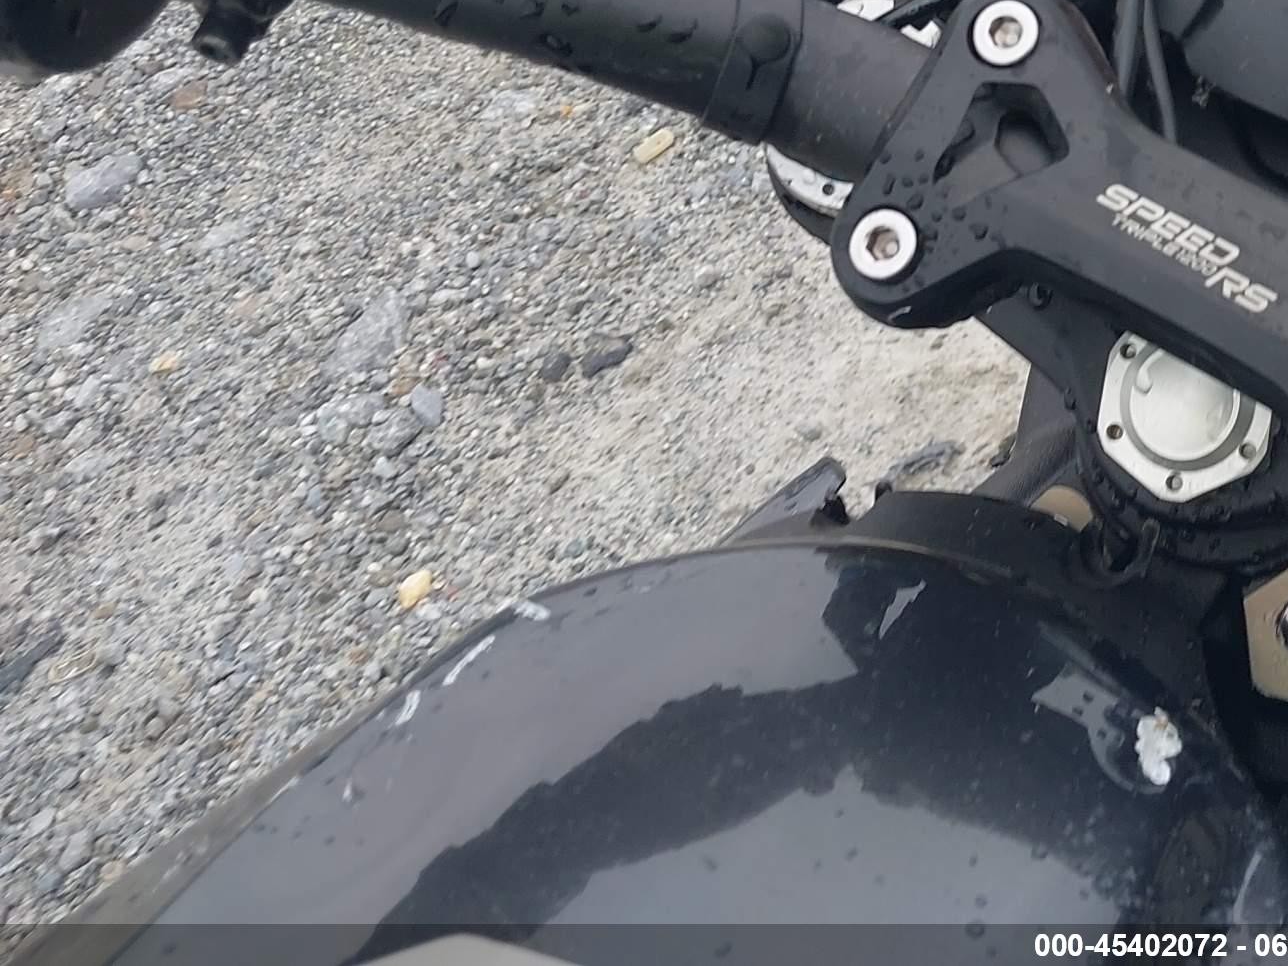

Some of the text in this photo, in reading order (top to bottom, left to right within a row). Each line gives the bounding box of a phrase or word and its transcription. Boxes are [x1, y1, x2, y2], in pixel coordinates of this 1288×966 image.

[1096, 183, 1241, 267] SPEED
[1111, 213, 1179, 257] TRIPLE
[1204, 266, 1279, 313] RS
